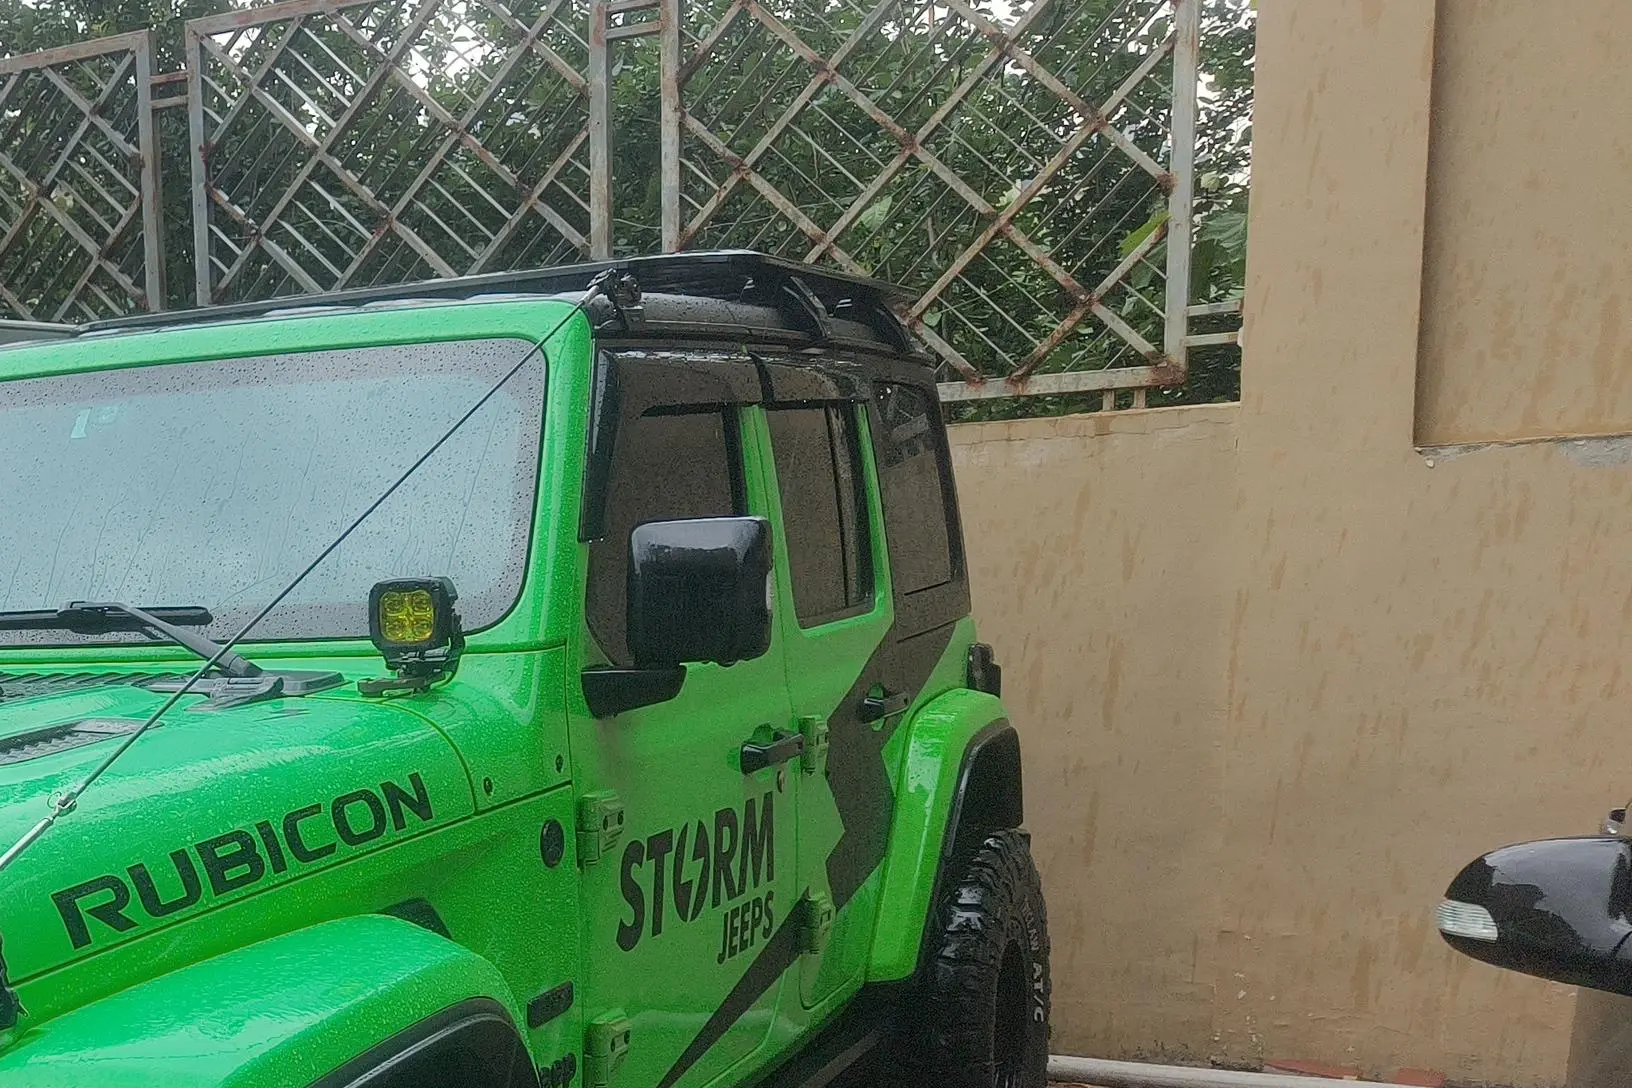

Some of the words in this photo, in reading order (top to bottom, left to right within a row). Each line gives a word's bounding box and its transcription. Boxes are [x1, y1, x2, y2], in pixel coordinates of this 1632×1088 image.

[51, 772, 434, 950] RUBICON
[616, 791, 775, 952] STORM
[718, 890, 775, 964] JEEPS
[1032, 962, 1044, 1022] AT/C
